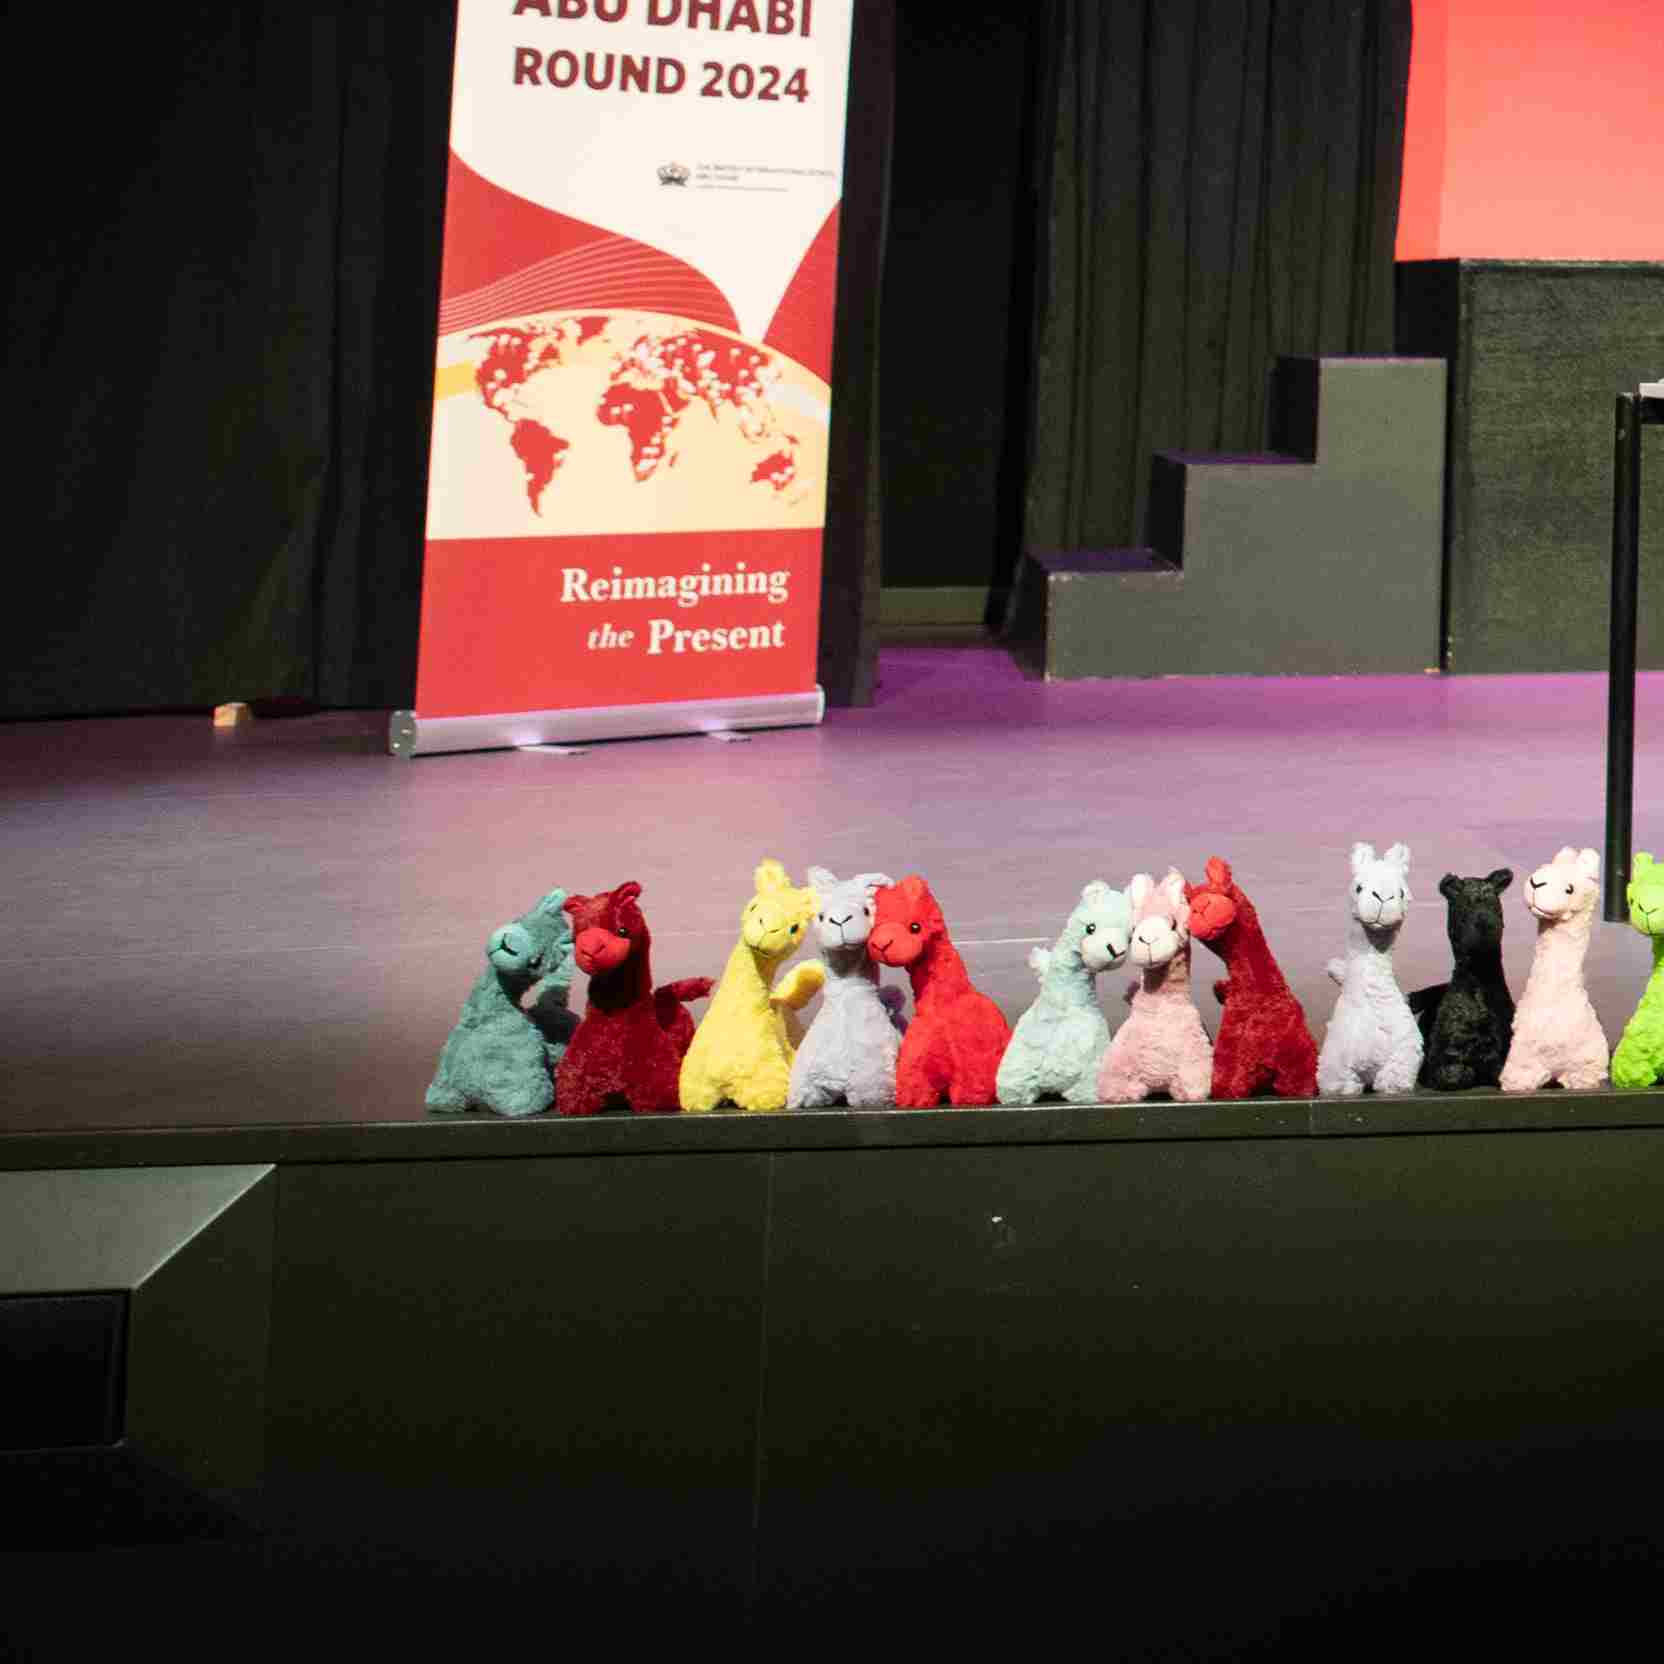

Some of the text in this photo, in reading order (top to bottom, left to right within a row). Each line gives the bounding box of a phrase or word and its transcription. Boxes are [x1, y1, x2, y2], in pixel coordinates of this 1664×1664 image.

[513, 47, 811, 104] ROUND 2024
[560, 561, 792, 608] Reimagining
[587, 618, 786, 656] the Present
